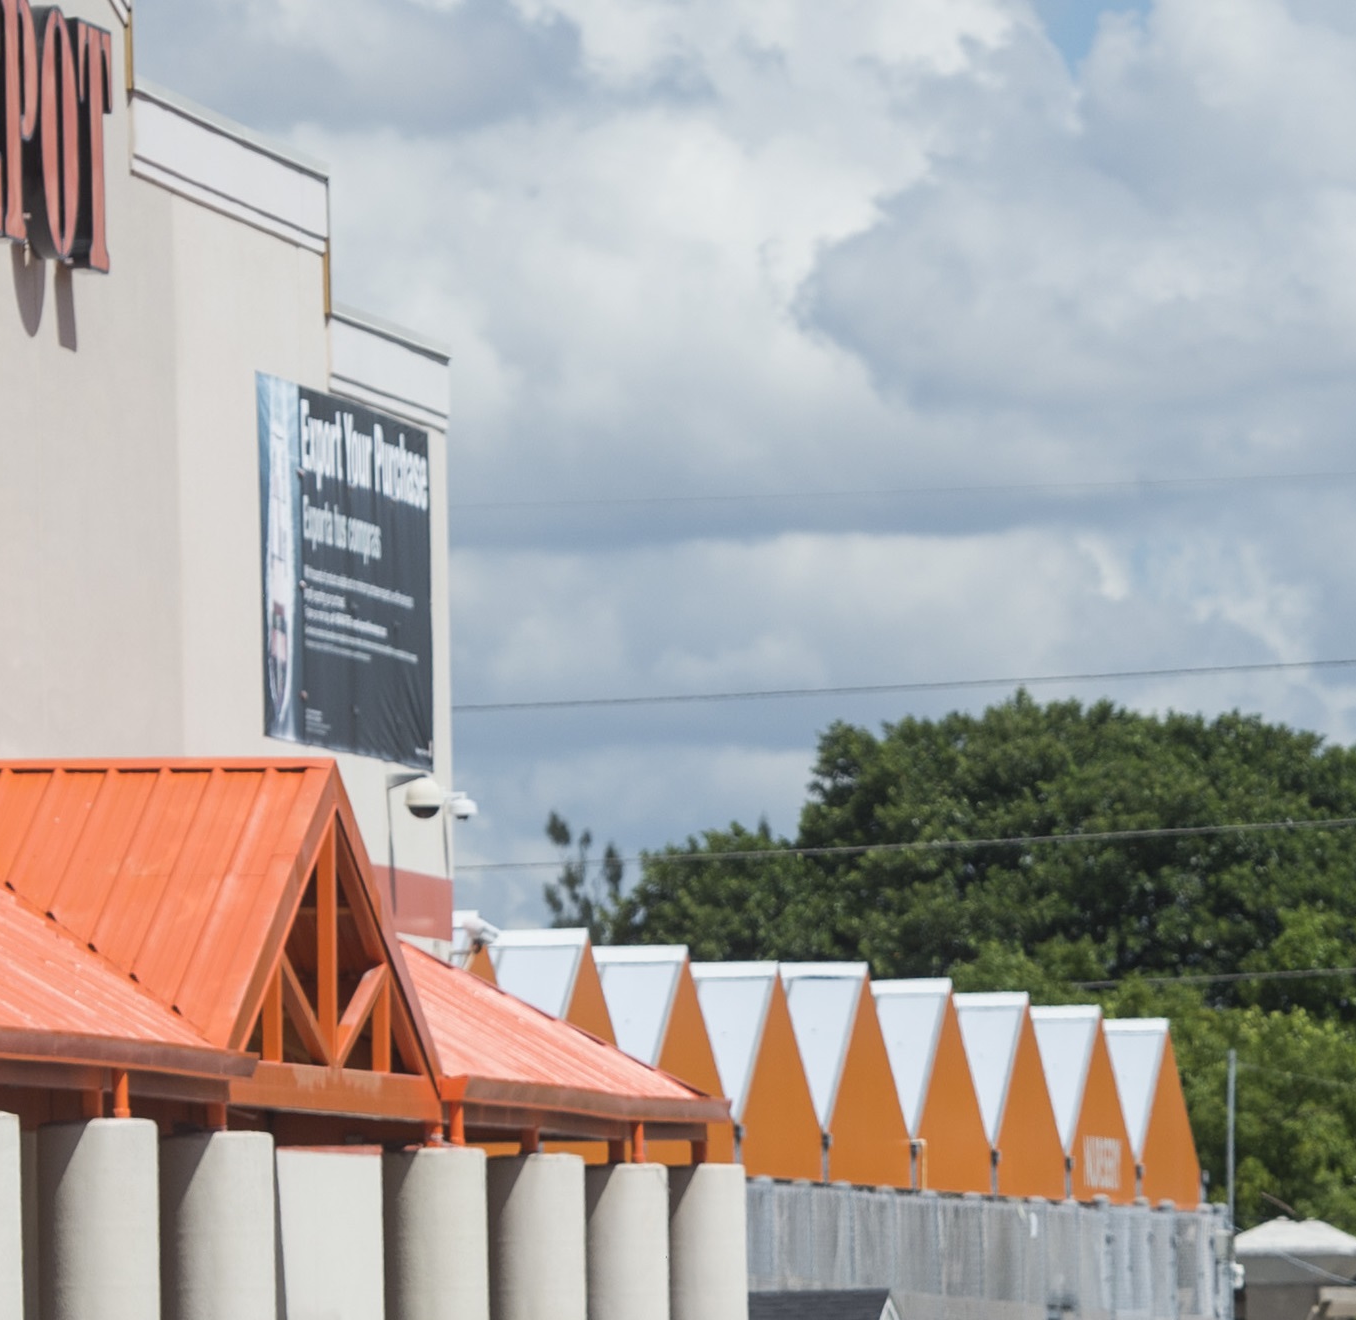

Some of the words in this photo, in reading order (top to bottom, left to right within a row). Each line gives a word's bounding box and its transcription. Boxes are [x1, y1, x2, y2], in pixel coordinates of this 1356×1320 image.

[299, 398, 343, 492] Export
[343, 411, 372, 489] Your
[373, 422, 428, 511] Purchase
[347, 516, 382, 566] compras
